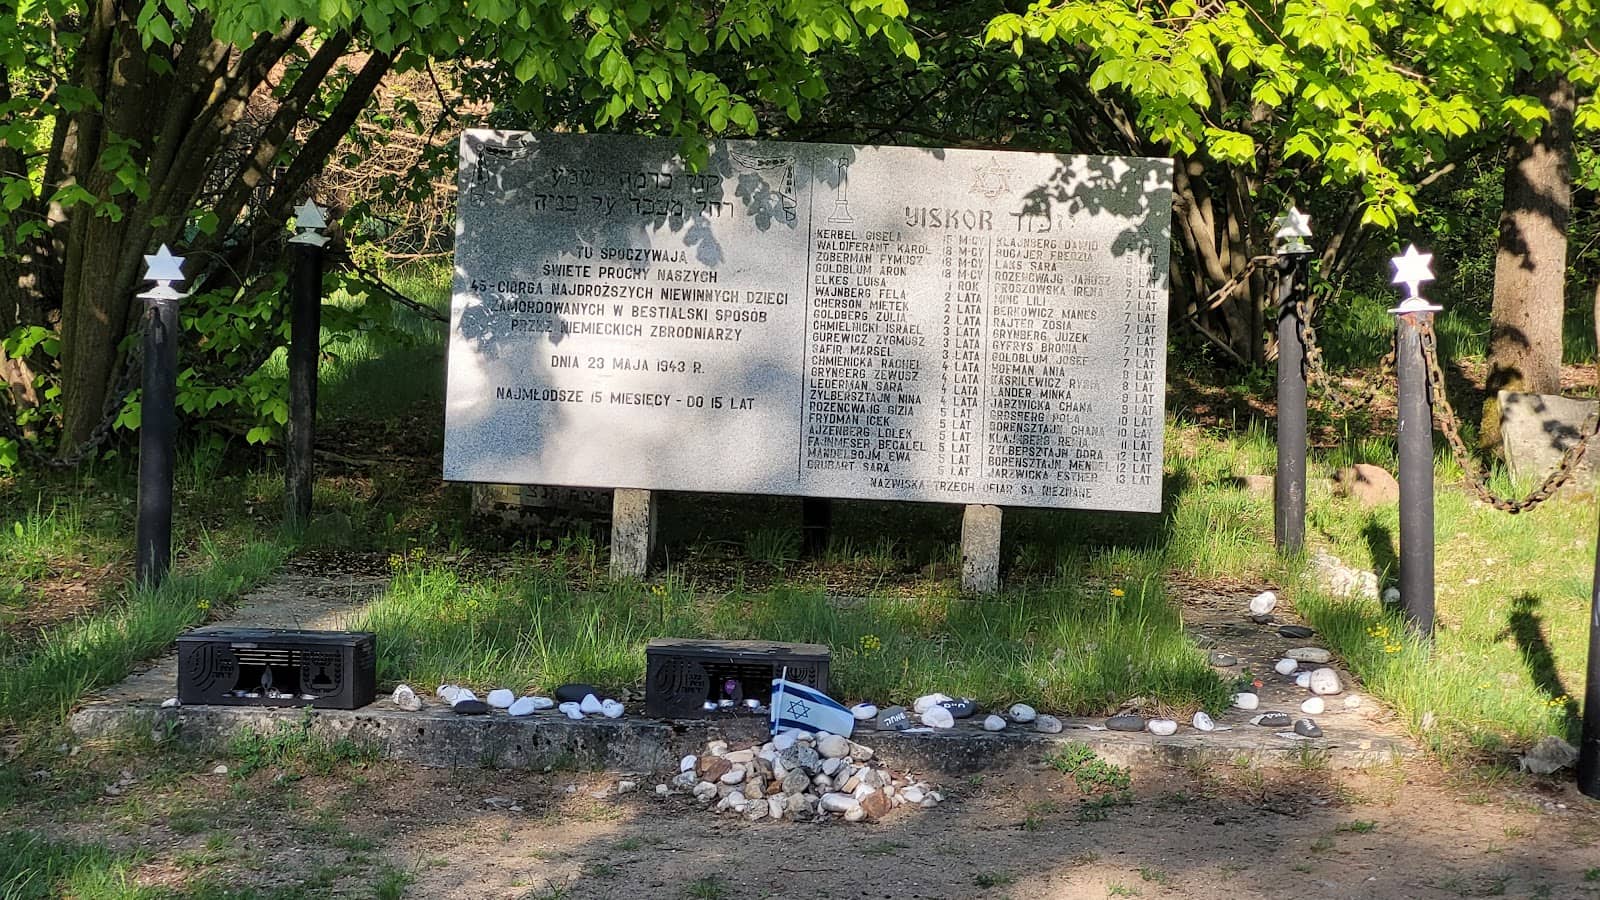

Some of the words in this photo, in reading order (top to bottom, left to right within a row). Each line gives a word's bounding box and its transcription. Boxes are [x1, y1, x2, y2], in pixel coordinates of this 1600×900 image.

[905, 206, 993, 231] YISKOR
[816, 228, 857, 239] KERBEL
[576, 246, 593, 259] TU
[816, 251, 871, 263] ZOBERMAN
[815, 263, 871, 274] GOLDBLUM
[879, 266, 906, 276] ARON
[1030, 261, 1056, 271] SARA
[598, 266, 650, 280] PROCHY
[657, 268, 718, 283] NASZYCH
[815, 274, 848, 285] ELKES
[857, 276, 886, 287] LUISA
[958, 281, 978, 291] ROK
[551, 281, 653, 299] NAJDROŻSZYCH
[660, 287, 739, 303] NIEWINNYCH
[746, 291, 788, 305] DZIECI
[815, 286, 870, 298] WAJNBERG
[879, 289, 906, 299] FELA
[944, 292, 950, 301] 2
[957, 293, 981, 303] LATA
[1138, 289, 1156, 299] LAT
[490, 299, 605, 317] ZAMORDOWANYCH
[613, 305, 623, 317] W
[631, 305, 708, 321] BESTIALSKI
[715, 308, 767, 323] SPOSÓB
[814, 298, 861, 309] CHERSON
[870, 300, 908, 311] MIETEK
[944, 304, 950, 313] 2
[957, 304, 981, 314] LATA
[1026, 296, 1045, 306] LILI
[1125, 300, 1131, 310] 7
[1138, 301, 1156, 311] LAT
[813, 309, 867, 321] GOLDBERG
[943, 315, 949, 324] 2
[956, 316, 980, 326] LATA
[993, 306, 1053, 317] BERKOWICZ
[1124, 312, 1130, 321] 7
[1137, 312, 1155, 322] LAT
[560, 321, 642, 337] NIEMIECKICH
[650, 325, 742, 342] ZBRODNIARZY
[813, 321, 878, 333] CHMIELNICKI
[886, 324, 923, 335] ISRAEL
[943, 327, 949, 336] 3
[956, 327, 980, 338] LATA
[1042, 320, 1071, 330] ZOSIA
[1124, 323, 1130, 333] 7
[1137, 324, 1155, 334] LAT
[812, 332, 867, 344] GUREWICZ
[876, 335, 924, 346] ZYGMUSZ
[943, 338, 948, 348] 3
[955, 339, 979, 349] LATA
[992, 329, 1046, 340] GRYNBERG
[1055, 332, 1088, 342] JUZEK
[1136, 336, 1155, 345] LAT
[812, 344, 842, 354] SAFIR
[850, 346, 893, 356] MARSEL
[942, 350, 948, 359] 3
[955, 350, 979, 361] LATA
[1041, 343, 1077, 353] BRONIA
[1136, 347, 1155, 357] LAT
[551, 355, 580, 369] DNIA
[587, 356, 604, 370] 23
[612, 357, 649, 372] MAJA
[656, 360, 686, 373] 1943
[941, 361, 947, 371] 4
[954, 362, 979, 372] LATA
[992, 352, 1047, 363] GOLDBLUM
[1122, 358, 1129, 367] 7
[1136, 359, 1155, 368] LAT
[811, 367, 865, 378] GRYNBERG
[954, 374, 978, 384] LATA
[1043, 366, 1064, 376] ANIA
[1135, 370, 1154, 380] LAT
[810, 378, 867, 390] LEDERMAN
[876, 381, 903, 392] SARA
[954, 385, 978, 395] LATA
[1135, 382, 1154, 392] LAT
[496, 386, 583, 403] NAJMŁODSZE
[590, 391, 602, 404] 15
[686, 395, 704, 408] DO
[711, 396, 722, 409] 15
[730, 397, 755, 411] LAT
[810, 390, 890, 403] ZYLBERSZTAJN
[898, 394, 921, 404] NINA
[953, 397, 977, 407] LATA
[990, 386, 1031, 397] LANDER
[1040, 389, 1071, 399] MINKA
[1135, 393, 1154, 403] LAT
[887, 405, 913, 415] GIZIA
[940, 408, 946, 417] 5
[952, 408, 972, 418] LAT
[1134, 405, 1153, 415] LAT
[809, 413, 858, 424] FRYDMAN
[866, 416, 889, 426] ICEK
[939, 419, 945, 428] 5
[952, 420, 971, 430] LAT
[1118, 416, 1127, 425] 10
[1134, 416, 1153, 426] LAT
[809, 425, 869, 436] AJZENBERG
[878, 428, 912, 438] LOLEK
[952, 431, 971, 441] LAT
[1117, 427, 1126, 437] 10
[1133, 428, 1152, 438] LAT
[938, 442, 944, 452] 5
[951, 443, 970, 453] LAT
[1121, 439, 1126, 448] 11
[1133, 440, 1152, 449] LAT
[889, 452, 910, 462] EWA
[951, 454, 970, 464] LAT
[1076, 448, 1102, 459] DORA
[1116, 450, 1126, 460] 12
[1133, 451, 1152, 461] LAT
[863, 462, 889, 472] SARA
[950, 466, 969, 476] LAT
[1116, 462, 1126, 471] 12
[1132, 463, 1151, 472] LAT
[1116, 473, 1125, 483] 13
[1131, 474, 1151, 484] LAT
